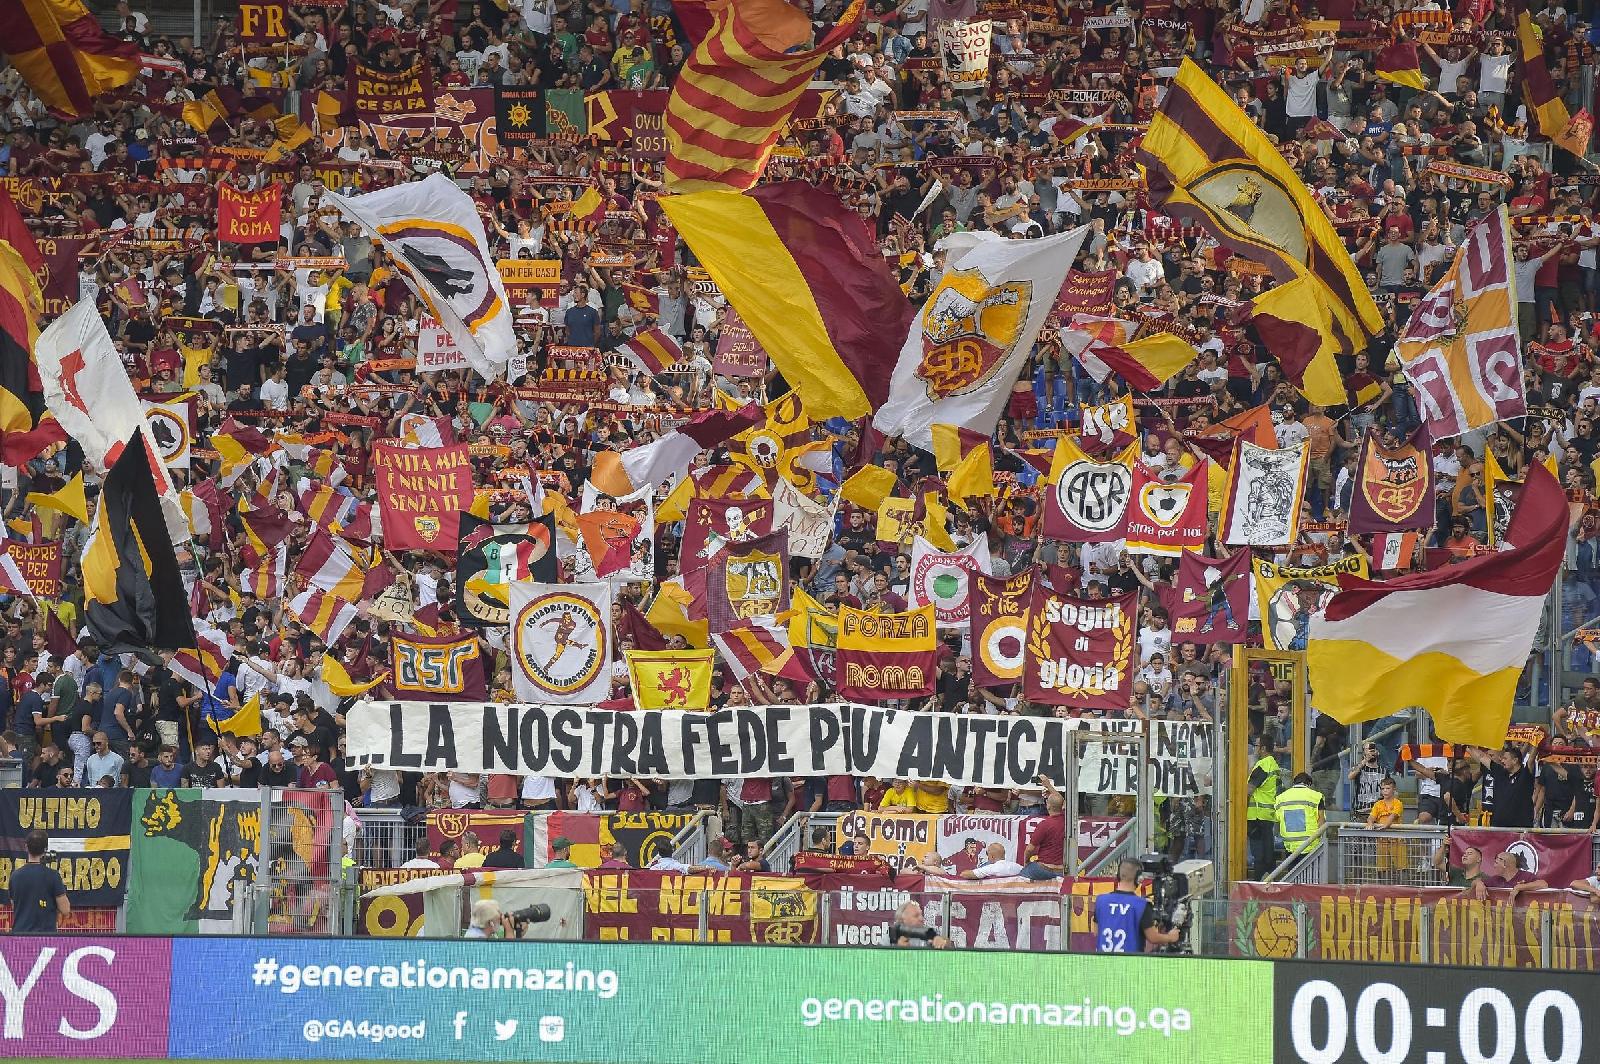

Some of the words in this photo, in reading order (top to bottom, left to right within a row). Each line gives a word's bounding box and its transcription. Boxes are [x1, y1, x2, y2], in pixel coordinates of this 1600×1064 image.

[239, 4, 288, 38] FR
[1141, 18, 1155, 26] AS
[1157, 18, 1187, 32] ROMA
[944, 37, 986, 51] BEVO
[357, 78, 423, 97] ROMA
[1072, 91, 1099, 101] ROMA
[356, 99, 379, 111] CE
[382, 99, 404, 112] SA
[407, 96, 427, 109] FA
[504, 131, 537, 139] TESTACCIO
[240, 206, 258, 219] DE
[230, 220, 273, 237] ROMA
[517, 267, 533, 278] PER
[534, 267, 557, 278] CASO
[423, 351, 467, 366] ROMA
[550, 348, 589, 358] ROMA
[721, 353, 741, 366] PER
[742, 353, 758, 366] LEI
[1082, 402, 1130, 445] ASR
[375, 448, 392, 468] LA
[393, 453, 433, 472] VITA
[435, 449, 469, 470] MIA
[399, 471, 458, 492] NIENTE
[389, 494, 440, 513] SENZA
[441, 494, 462, 512] TE
[1068, 471, 1126, 522] ASR
[7, 545, 57, 561] SEMPRE
[27, 562, 49, 577] PER
[526, 604, 562, 628] SQUADRA
[843, 613, 929, 640] FORZA
[1045, 598, 1121, 631] Sogni
[1074, 636, 1089, 651] di
[846, 662, 925, 690] ROMA
[1039, 658, 1119, 691] gloria
[482, 706, 670, 775] NOSTRA
[681, 707, 795, 775] FEDE
[18, 797, 101, 830] ULTIMO
[842, 811, 866, 837] de
[869, 817, 928, 844] roma
[582, 874, 638, 914] NEL
[659, 876, 742, 916] NOME
[840, 885, 853, 911] il
[1108, 903, 1130, 915] TV
[1101, 928, 1127, 953] 32
[1320, 895, 1422, 962] BRIGATA
[1433, 897, 1517, 967] CURVA
[252, 958, 619, 999] #generationamazing
[801, 994, 1191, 1036] generationamazing.qa
[1291, 979, 1583, 1064] 00:00
[302, 1016, 426, 1042] @GA4good
